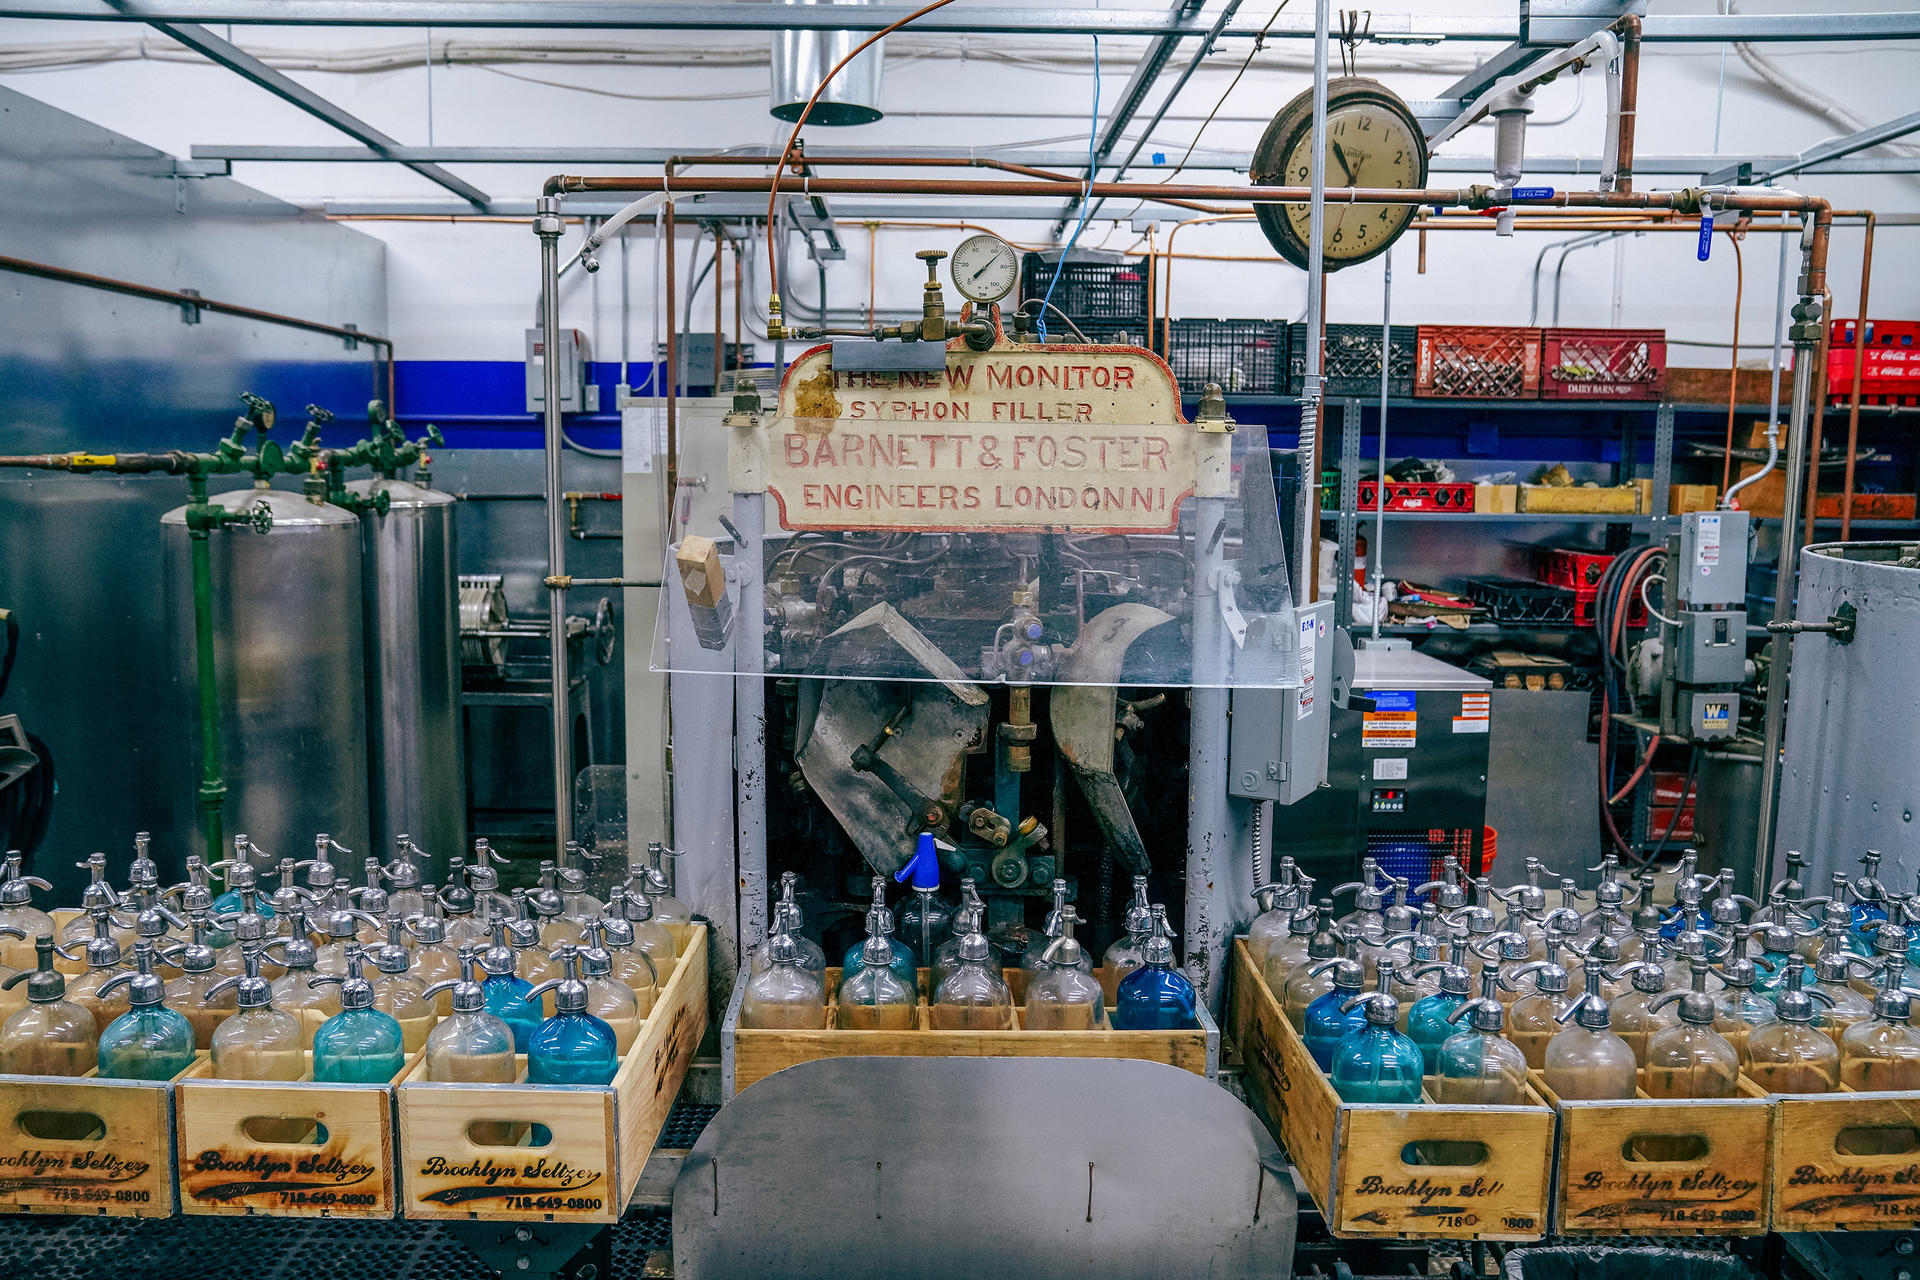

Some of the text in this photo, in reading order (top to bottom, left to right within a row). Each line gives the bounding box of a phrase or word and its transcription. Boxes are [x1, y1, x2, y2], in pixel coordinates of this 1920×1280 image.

[1334, 121, 1345, 136] 11
[1358, 116, 1372, 131] 12
[1384, 128, 1390, 143] 1
[1394, 151, 1403, 165] 2
[1299, 167, 1308, 182] 9
[1379, 208, 1388, 222] 4
[1333, 228, 1343, 243] 6
[1357, 225, 1367, 239] 5
[826, 364, 1135, 391] THE NEW MONITOR
[1568, 384, 1592, 393] DAIRY
[1593, 385, 1614, 394] BARN
[850, 401, 1092, 422] SYPHON FILLER
[784, 433, 973, 469] BARNETT
[1013, 436, 1171, 471] FOSTER
[803, 484, 980, 511] ENGINEERS
[70, 1151, 150, 1178] Seltzer
[195, 1151, 375, 1182] Brooklyn Seltzer
[421, 1156, 602, 1186] Brooklyn Seltzer
[1578, 1170, 1759, 1199] Brooklyn Seltzer
[1789, 1165, 1887, 1192] Brooklyn
[54, 1188, 150, 1202] 718-649-0800
[1356, 1175, 1453, 1204] Brooklyn
[279, 1191, 377, 1205] 718-649-0800
[505, 1196, 602, 1209] 718-649-0800
